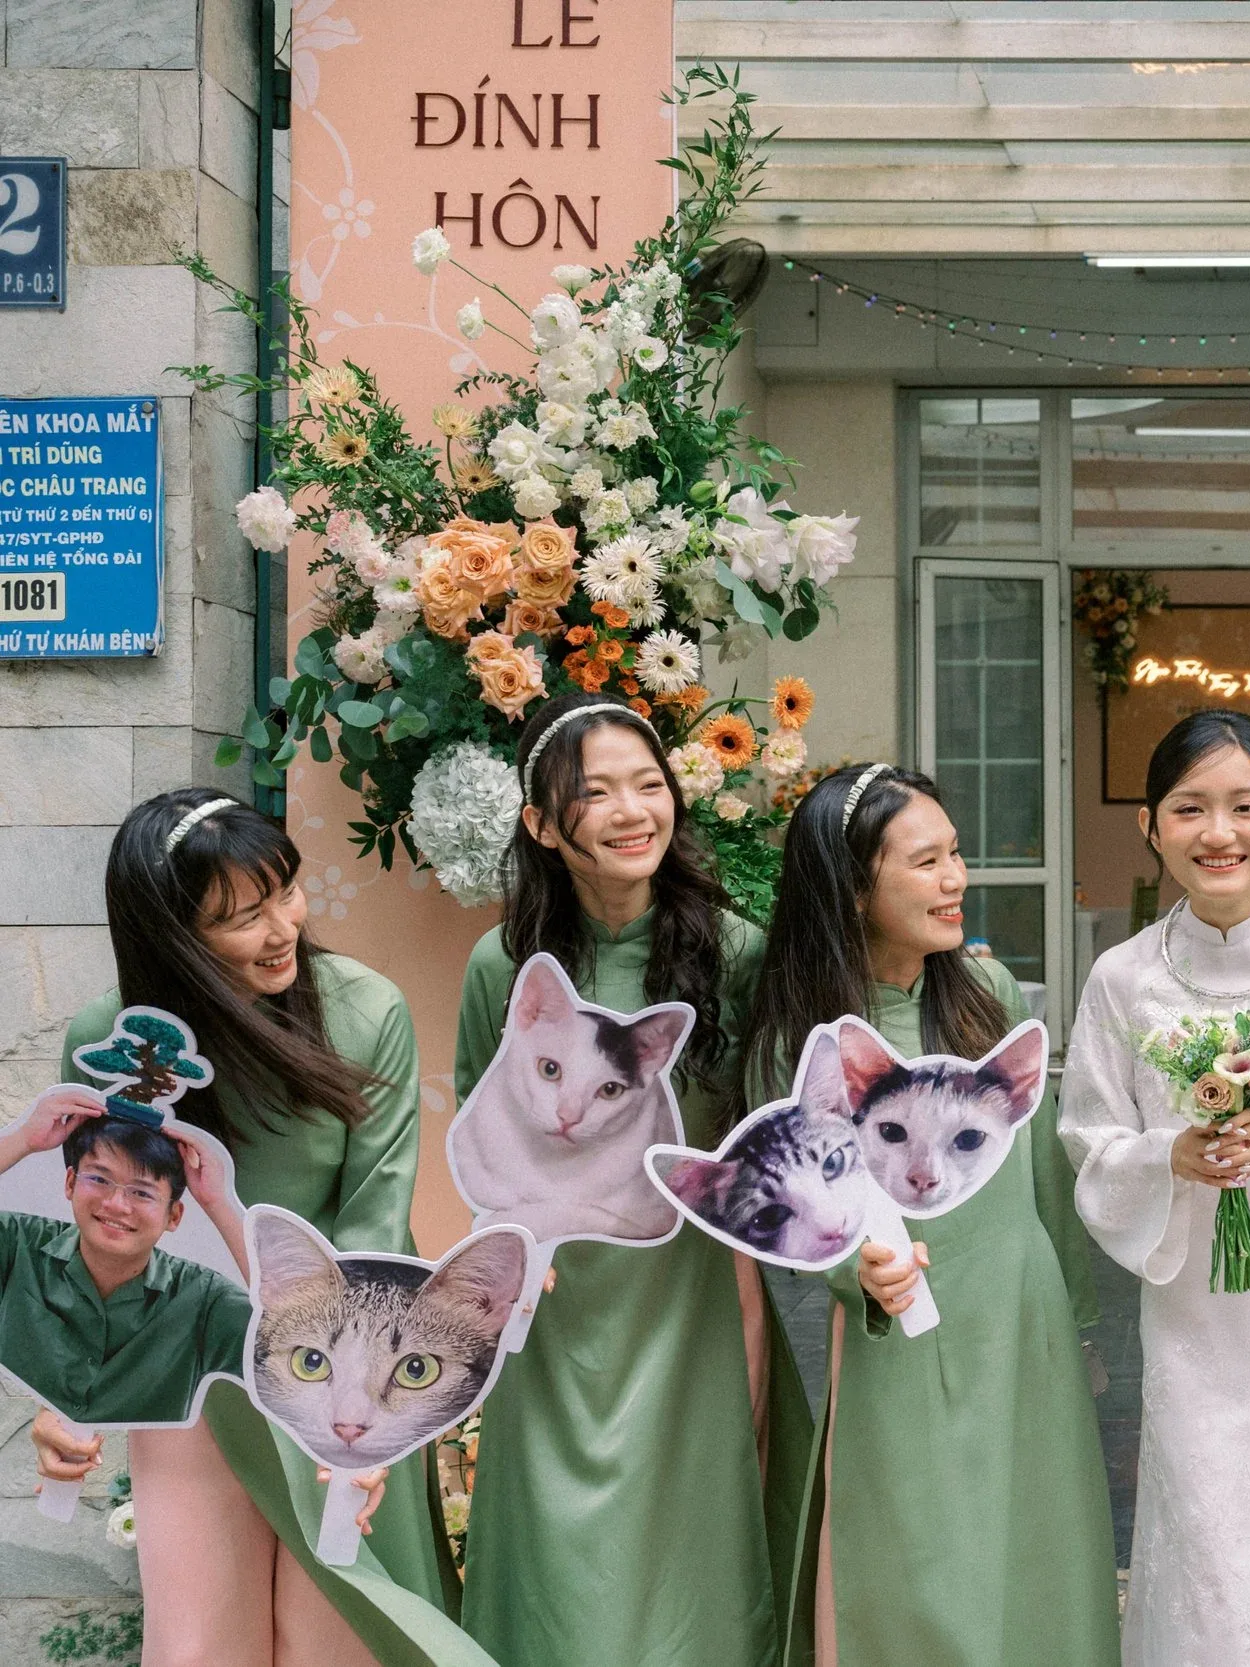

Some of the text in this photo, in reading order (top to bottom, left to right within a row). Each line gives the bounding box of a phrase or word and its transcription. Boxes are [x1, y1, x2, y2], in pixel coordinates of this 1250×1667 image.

[410, 74, 601, 148] ĐÍNH
[434, 177, 601, 250] HÔN
[36, 412, 101, 434] KHOA
[106, 404, 155, 433] MẮT
[8, 441, 41, 465] TRÍ
[47, 441, 102, 465] DŨNG
[20, 473, 75, 497] CHÂU
[81, 477, 147, 496] TRANG
[26, 505, 56, 523] THỨ
[60, 509, 69, 521] 2
[72, 504, 102, 521] ĐẾN
[106, 506, 137, 521] THỨ
[34, 551, 57, 569] HỆ
[62, 547, 109, 565] TỔNG
[113, 549, 142, 565] ĐÀI
[1, 579, 58, 611] 1081
[26, 630, 50, 656] TỰ
[54, 628, 105, 651] KHÁM
